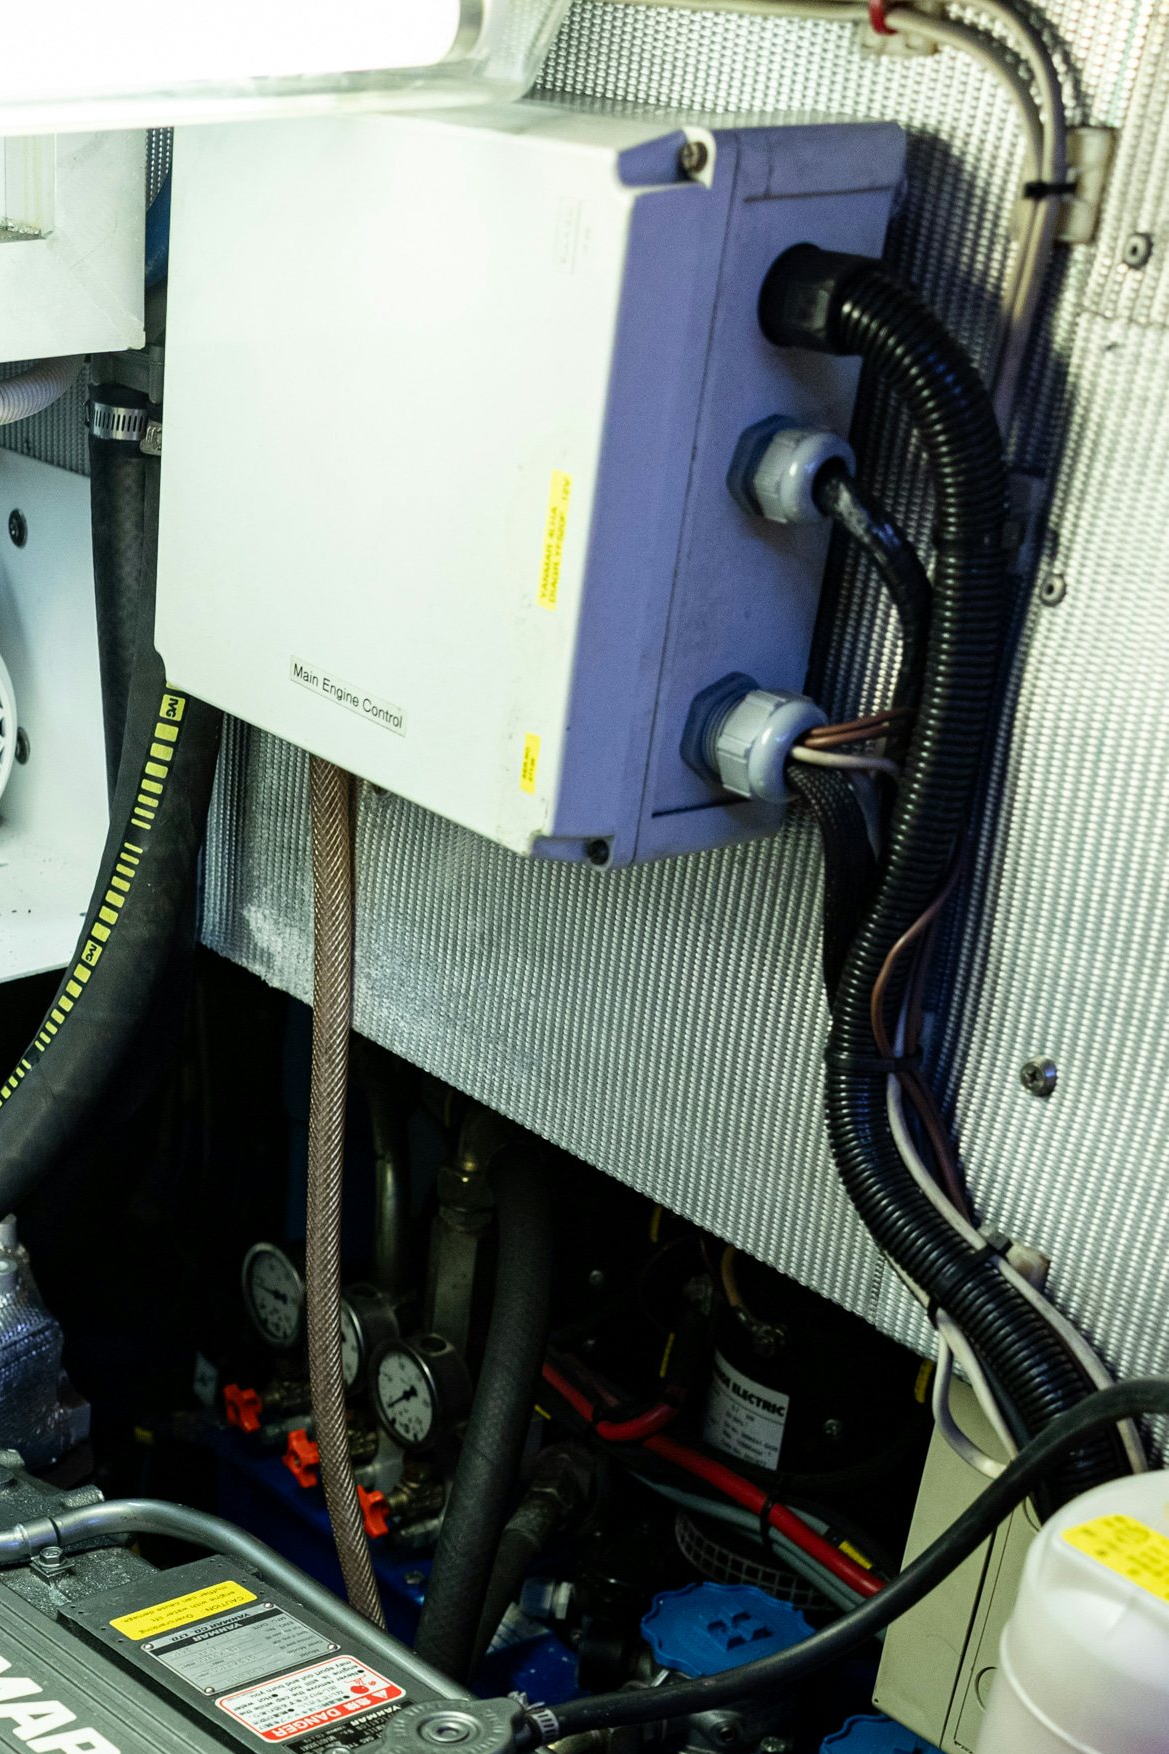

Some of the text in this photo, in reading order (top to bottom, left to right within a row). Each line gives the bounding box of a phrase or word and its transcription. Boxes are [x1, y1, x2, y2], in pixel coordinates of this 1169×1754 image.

[293, 660, 403, 731] Main Engine Control
[731, 1382, 786, 1417] ELECTRIC
[181, 1596, 197, 1604] can
[210, 1590, 235, 1602] engine
[157, 1602, 180, 1612] cause
[191, 1599, 207, 1607] with
[166, 1605, 189, 1617] water
[140, 1613, 194, 1634] Overcranking
[212, 1613, 250, 1628] YANMAR
[192, 1622, 244, 1641] YANMAR
[330, 1664, 359, 1676] engine
[284, 1678, 301, 1686] and
[304, 1679, 336, 1692] remove
[349, 1704, 403, 1726] YANMAR
[274, 1709, 340, 1737] DANGER
